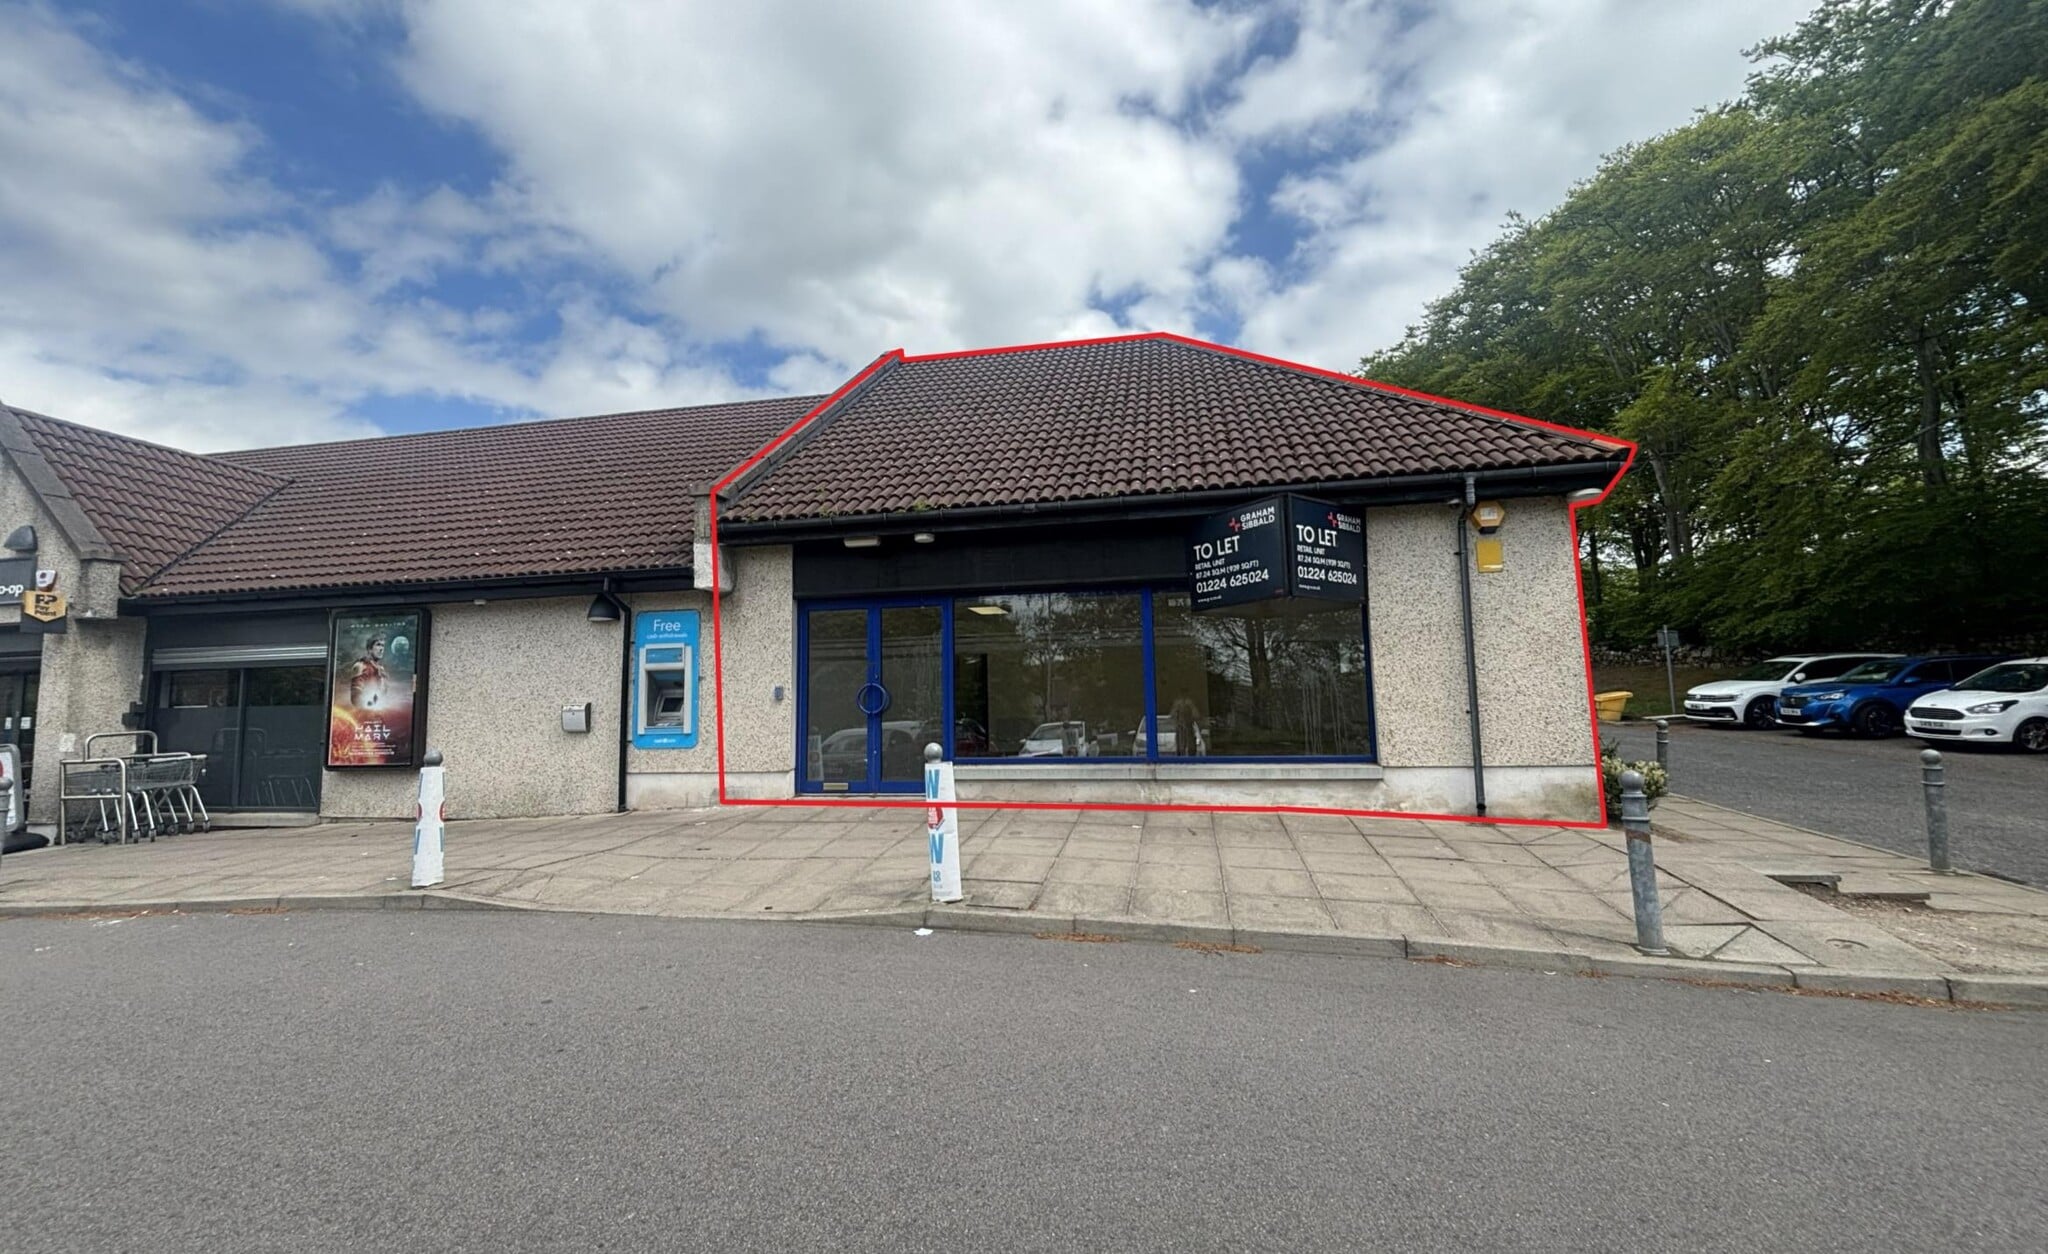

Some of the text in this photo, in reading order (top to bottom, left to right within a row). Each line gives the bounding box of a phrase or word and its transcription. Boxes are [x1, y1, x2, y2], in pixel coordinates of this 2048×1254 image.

[1240, 506, 1275, 522] GRAHAM
[1241, 514, 1276, 530] SIBBALD
[1336, 513, 1361, 526] GRAHAM
[1338, 520, 1361, 533] SIBBALD
[1296, 524, 1337, 547] TO LET
[1193, 535, 1240, 561] TO LET
[1196, 568, 1269, 593] 01224 625024
[1297, 565, 1357, 585] 01224 625024
[653, 619, 681, 632] Free
[353, 732, 391, 741] MARY
[354, 724, 391, 733] HAIL
